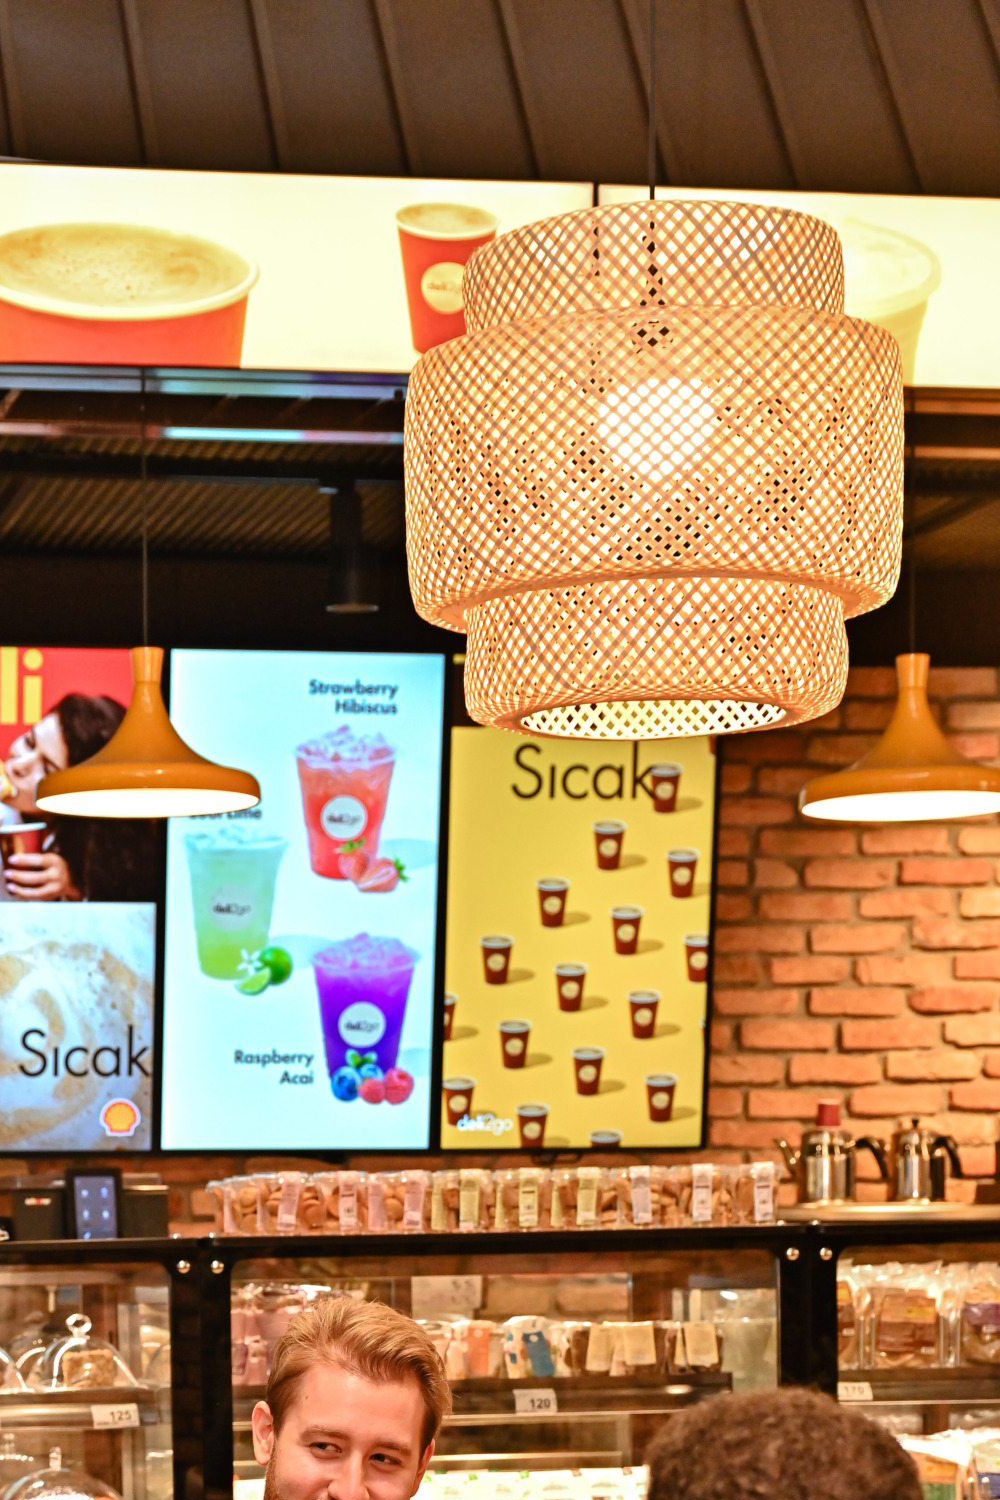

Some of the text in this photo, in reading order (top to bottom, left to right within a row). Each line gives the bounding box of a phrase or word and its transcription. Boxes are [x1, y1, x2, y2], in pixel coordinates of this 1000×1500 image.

[309, 678, 399, 700] Strawberry
[335, 699, 398, 714] Hibiscus
[234, 1049, 315, 1068] Raspberry
[279, 1070, 314, 1085] Acai
[109, 1410, 132, 1424] 125
